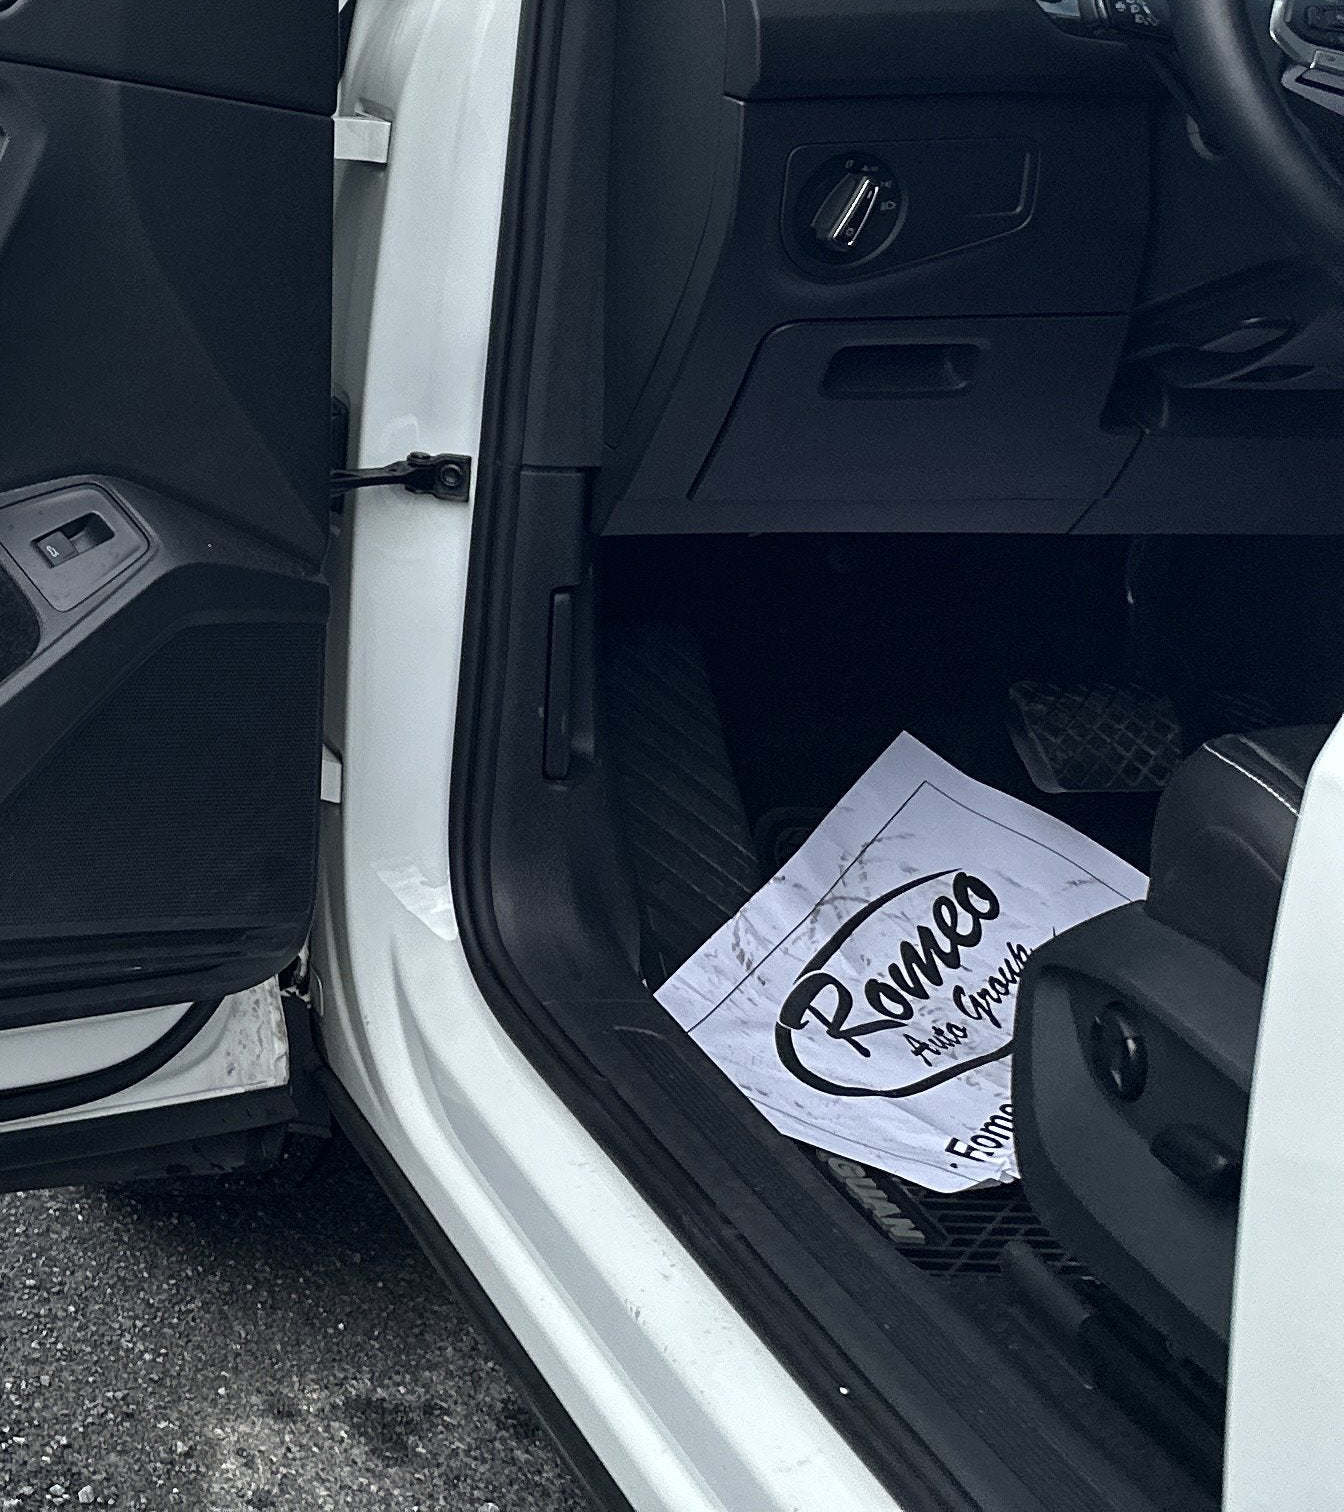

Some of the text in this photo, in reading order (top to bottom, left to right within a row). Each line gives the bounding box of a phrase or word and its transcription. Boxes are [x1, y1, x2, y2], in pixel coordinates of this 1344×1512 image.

[779, 871, 1000, 1058] Romeo
[903, 941, 1032, 1067] Auto Group
[816, 1149, 926, 1245] GUAN
